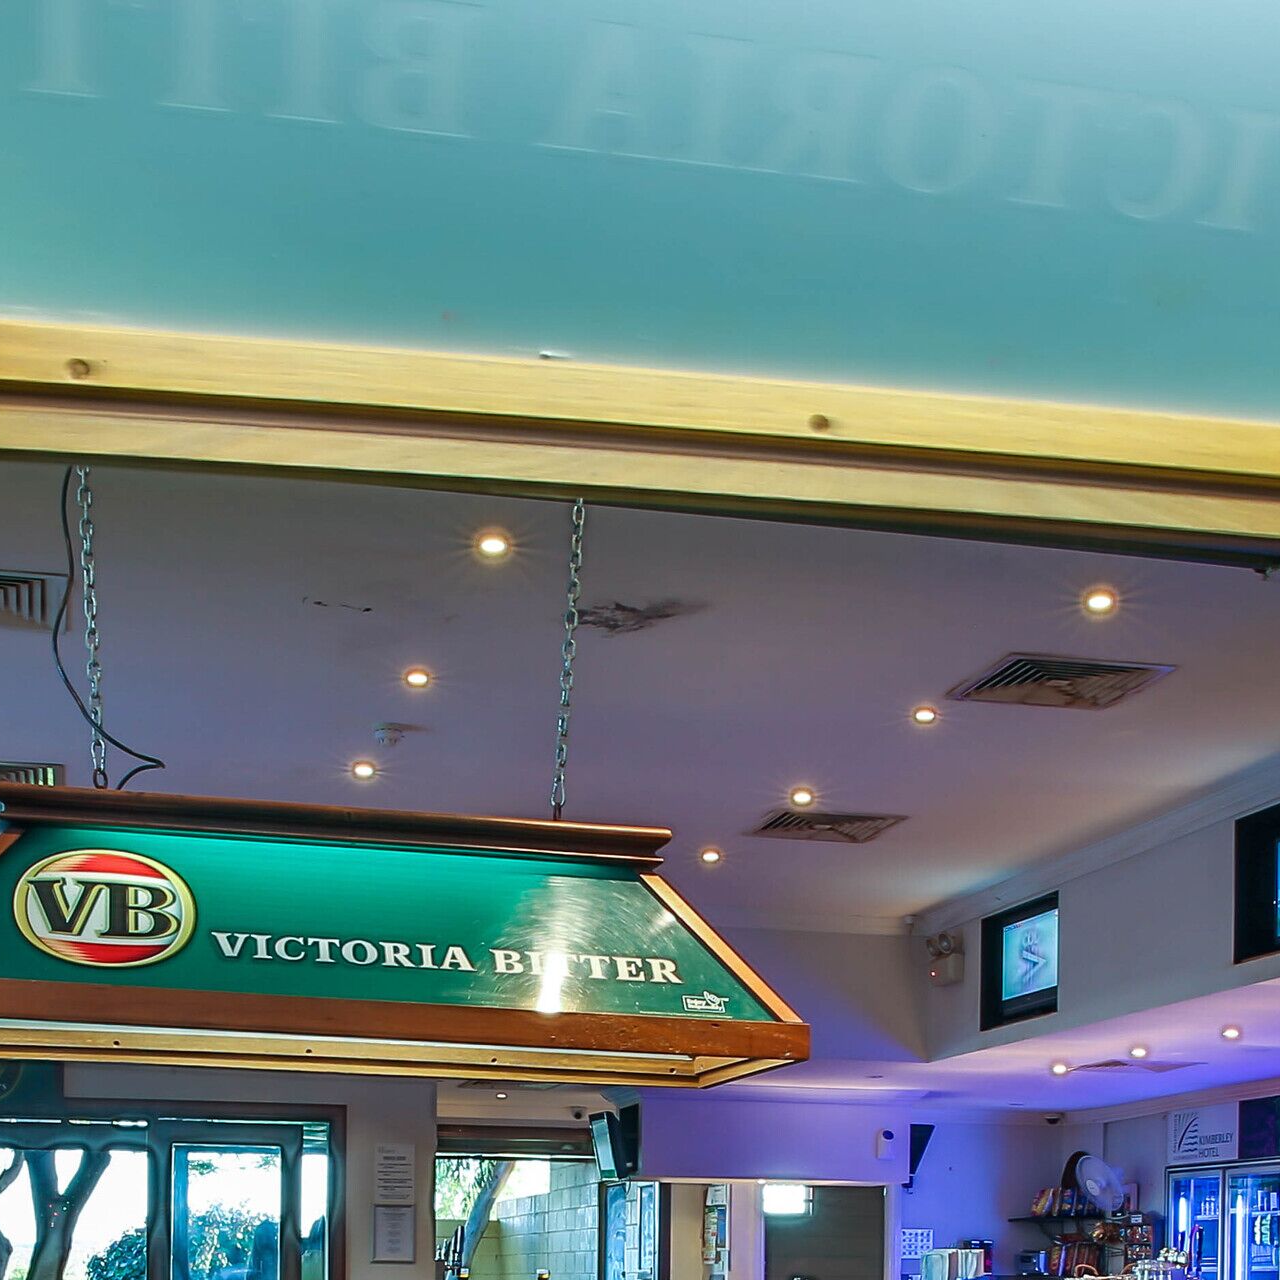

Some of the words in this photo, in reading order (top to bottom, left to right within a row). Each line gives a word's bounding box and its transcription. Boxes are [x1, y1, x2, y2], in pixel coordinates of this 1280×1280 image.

[27, 876, 182, 940] VB
[211, 931, 477, 973] VICTORIA
[1199, 1132, 1233, 1145] KIMBERLEY
[1199, 1147, 1219, 1158] HOTEL
